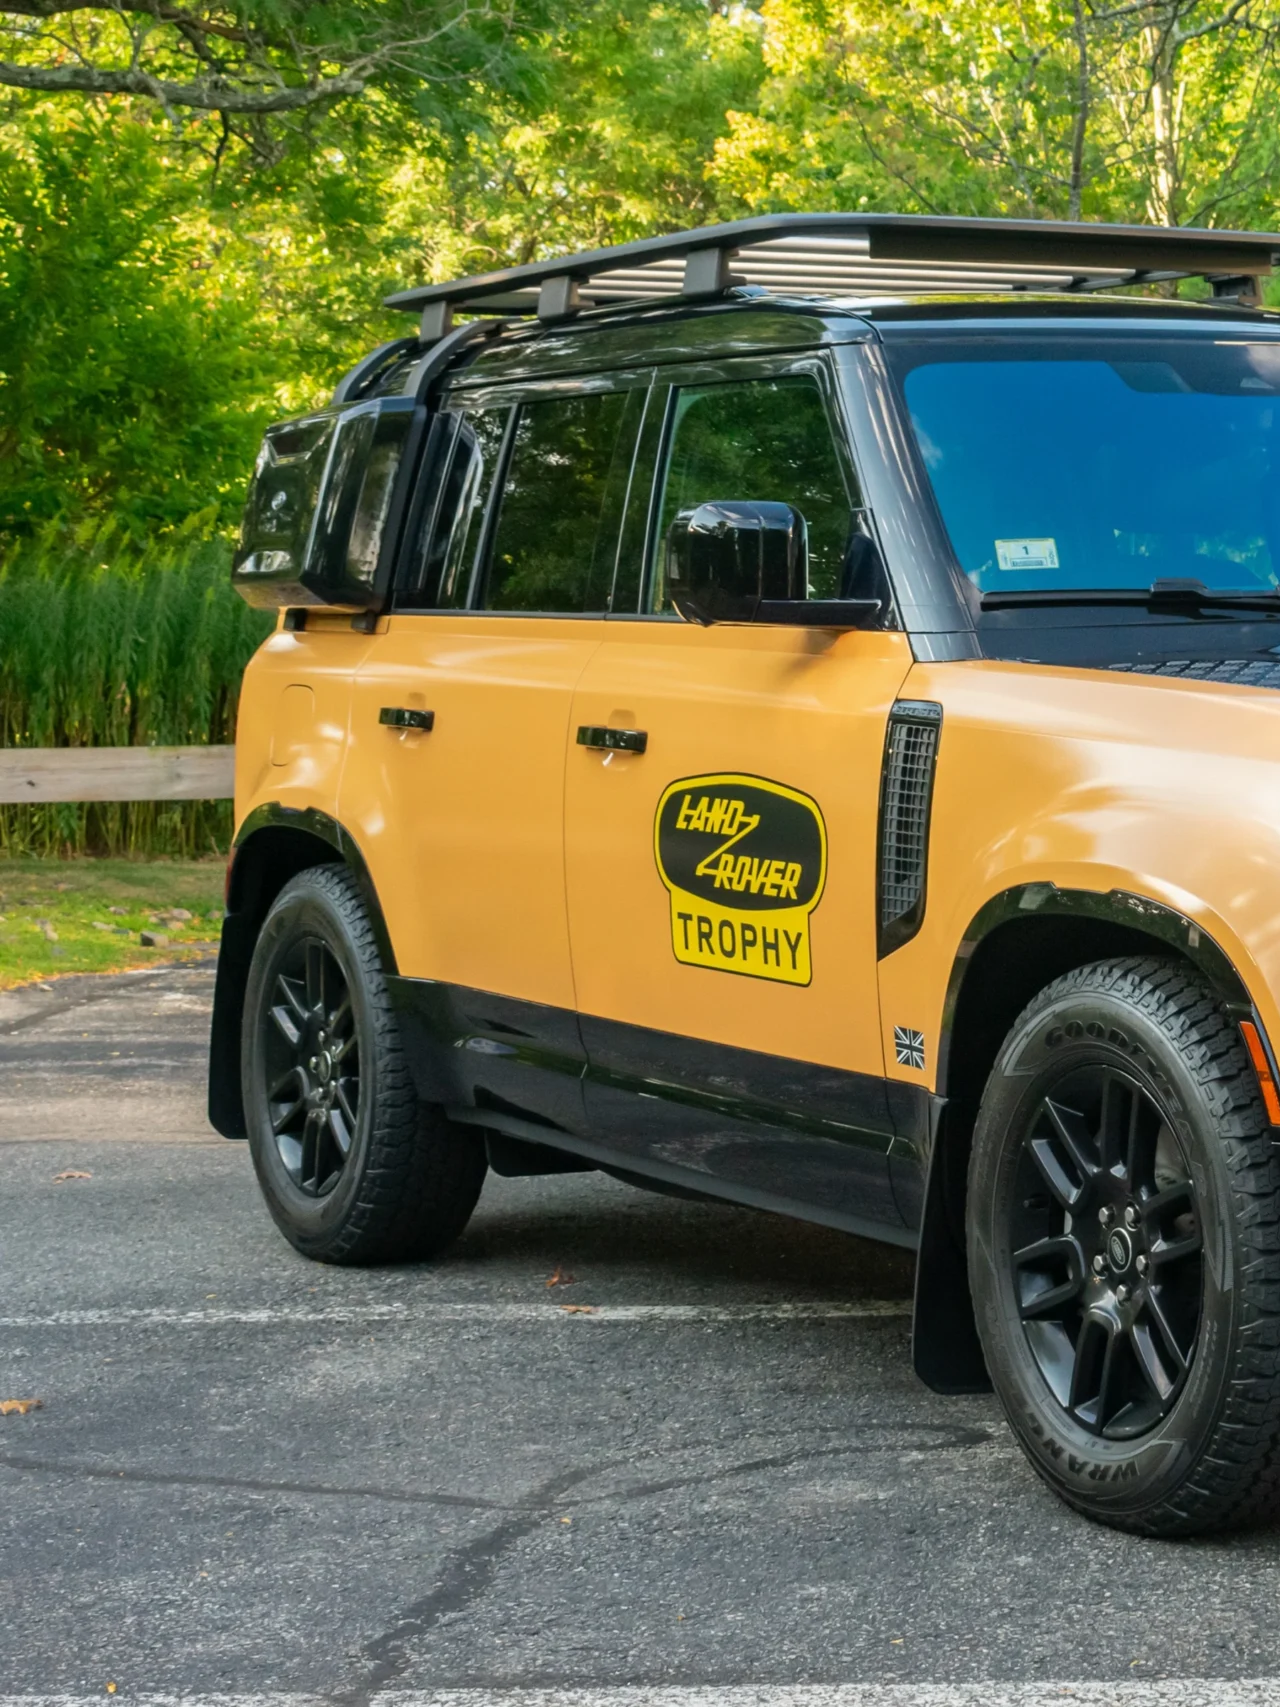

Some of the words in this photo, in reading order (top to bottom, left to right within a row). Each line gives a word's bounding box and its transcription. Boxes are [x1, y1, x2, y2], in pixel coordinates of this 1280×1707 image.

[1022, 545, 1029, 556] 1
[675, 794, 746, 836] LAND
[713, 852, 803, 901] ROVER
[676, 911, 803, 971] TROPHY
